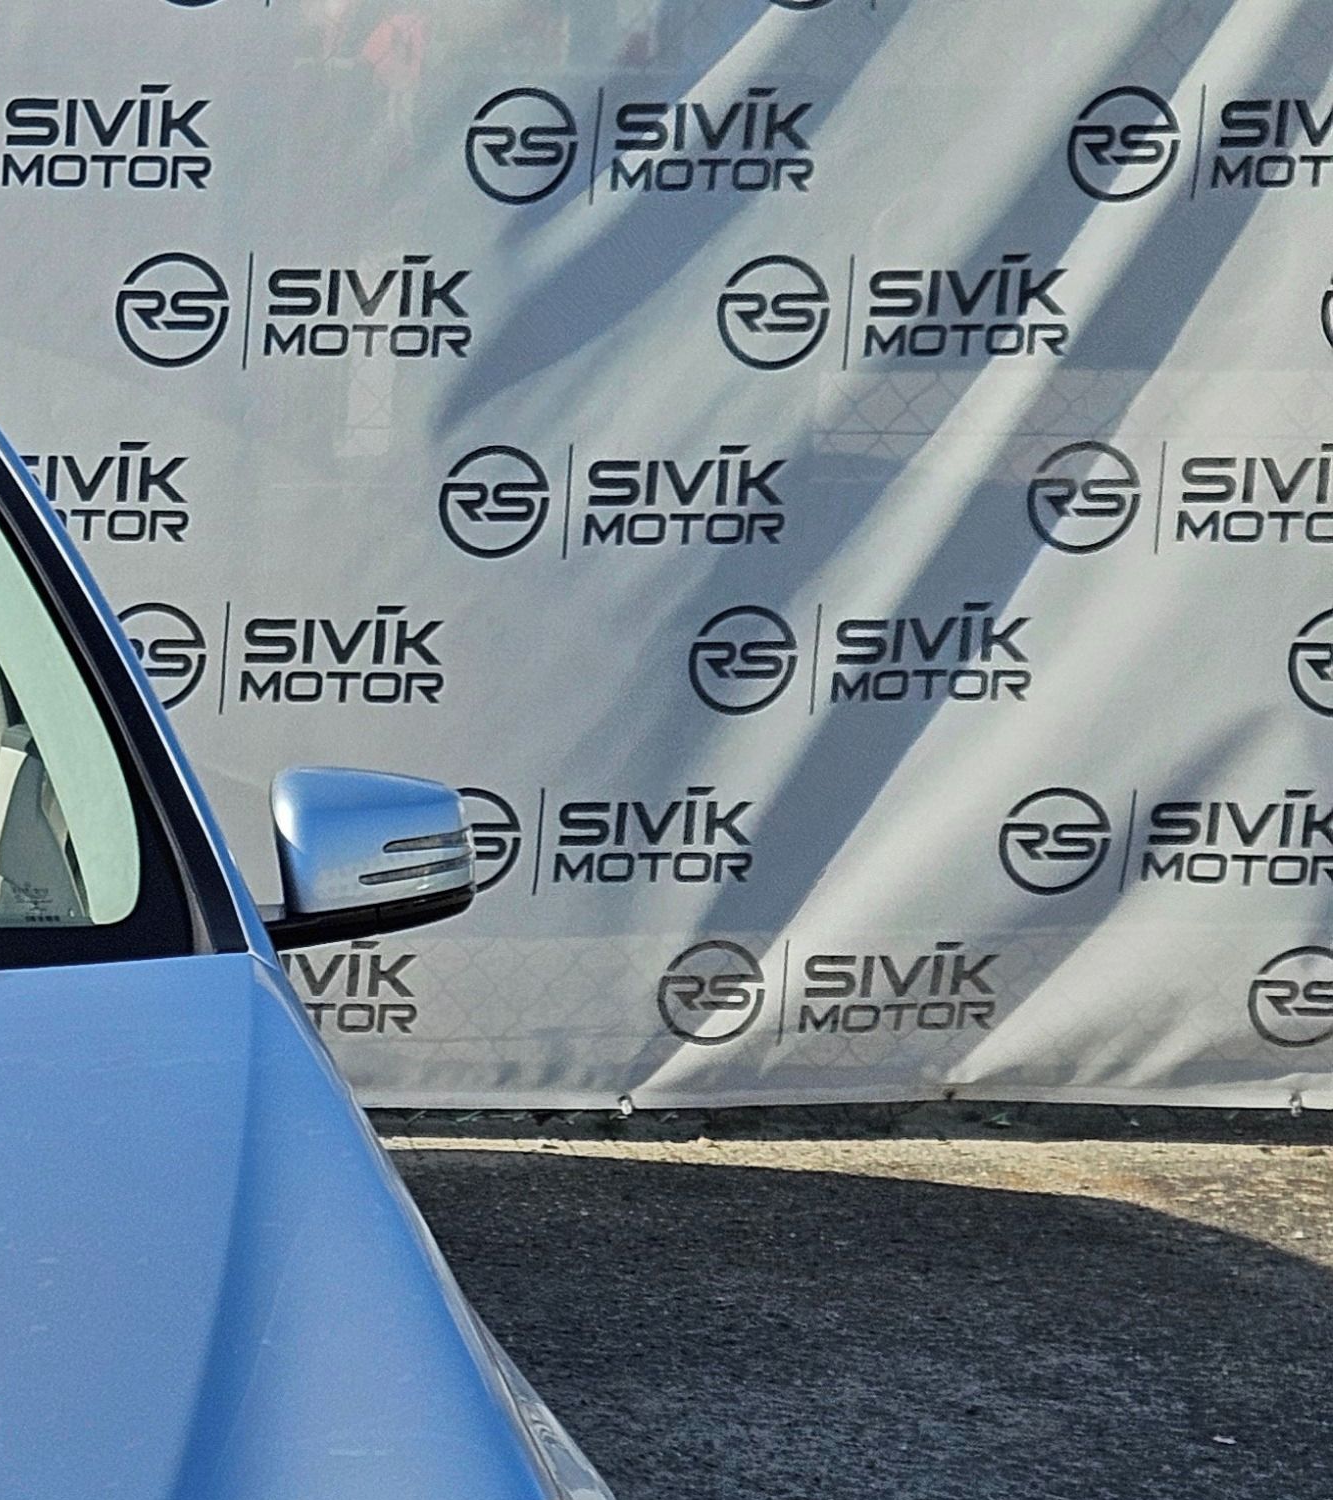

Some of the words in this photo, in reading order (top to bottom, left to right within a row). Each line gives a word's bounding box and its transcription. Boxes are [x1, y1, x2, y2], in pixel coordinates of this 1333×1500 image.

[1219, 99, 1333, 148] SIV
[2, 153, 211, 189] MOTOR
[610, 157, 814, 192] MOTOR
[1211, 155, 1333, 188] MOT
[264, 323, 472, 358] MOTOR
[864, 323, 1068, 357] MOTOR
[53, 509, 189, 542] TOR
[583, 513, 784, 546] MOTOR
[1176, 510, 1333, 543] MOTO
[239, 671, 444, 703] MOTOR
[831, 669, 1031, 703] MOTOR
[553, 852, 752, 883] MOTOR
[1141, 852, 1333, 886] MOTOR
[304, 1003, 417, 1034] TOR
[798, 1001, 995, 1033] MOTOR
